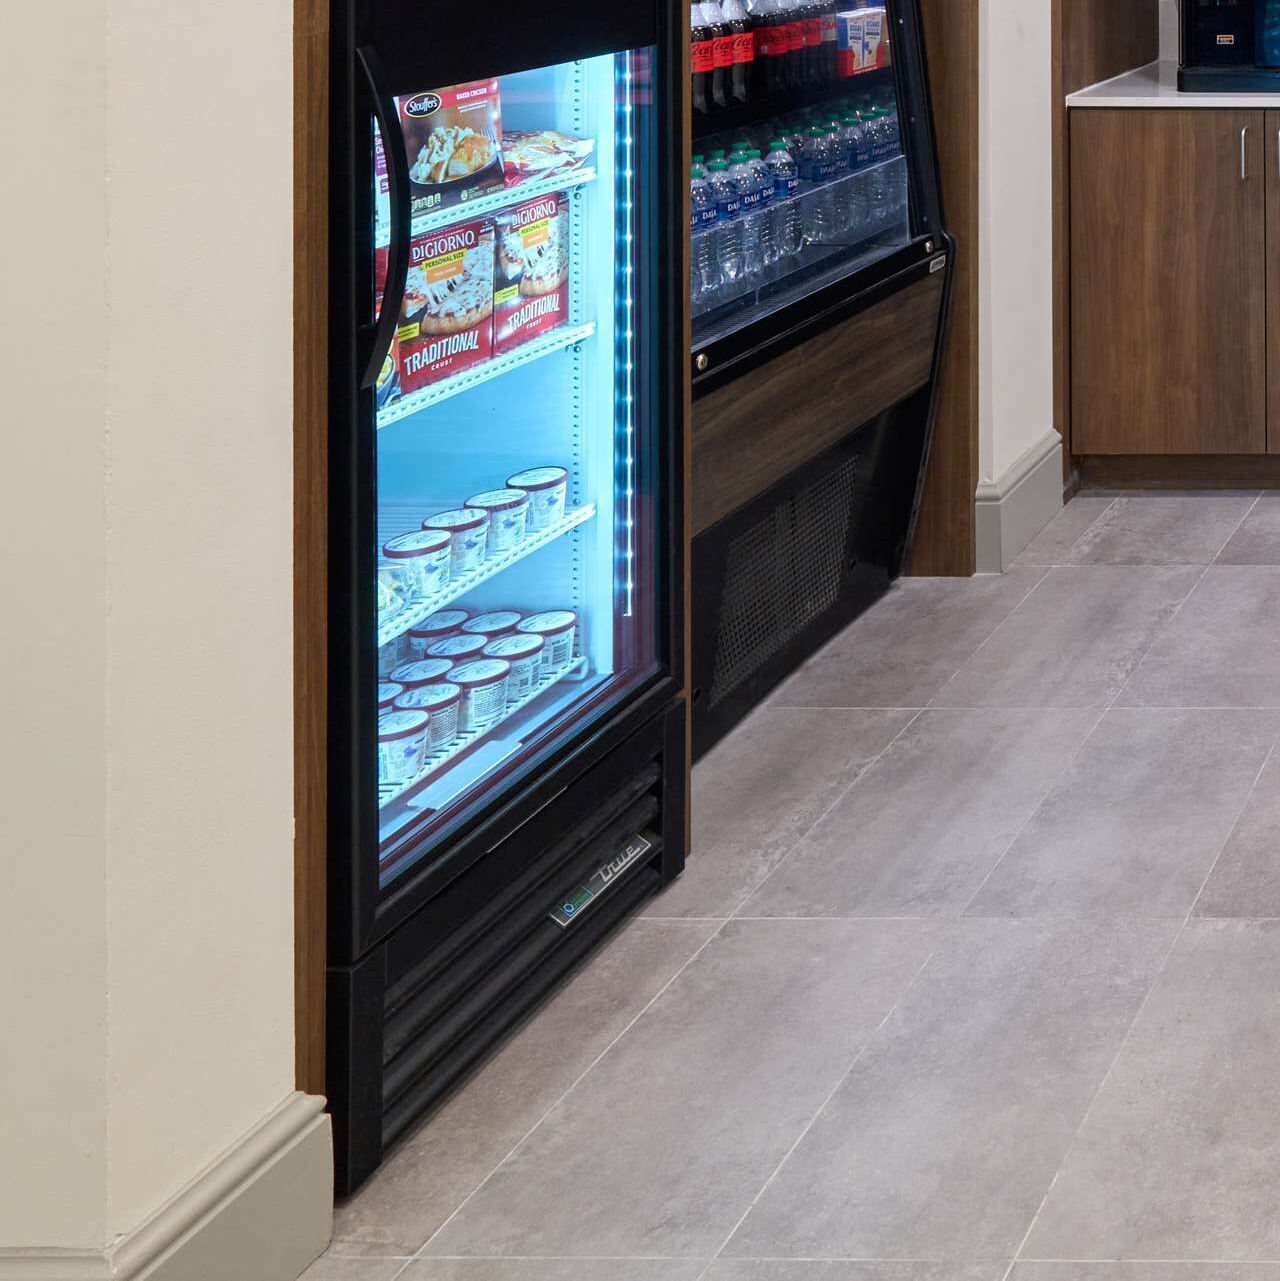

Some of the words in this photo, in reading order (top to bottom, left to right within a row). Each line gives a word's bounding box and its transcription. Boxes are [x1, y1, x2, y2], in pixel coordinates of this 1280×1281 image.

[508, 294, 560, 331] TRADITIONAL
[404, 330, 480, 376] TRADITIONAL
[431, 358, 453, 371] CRUST
